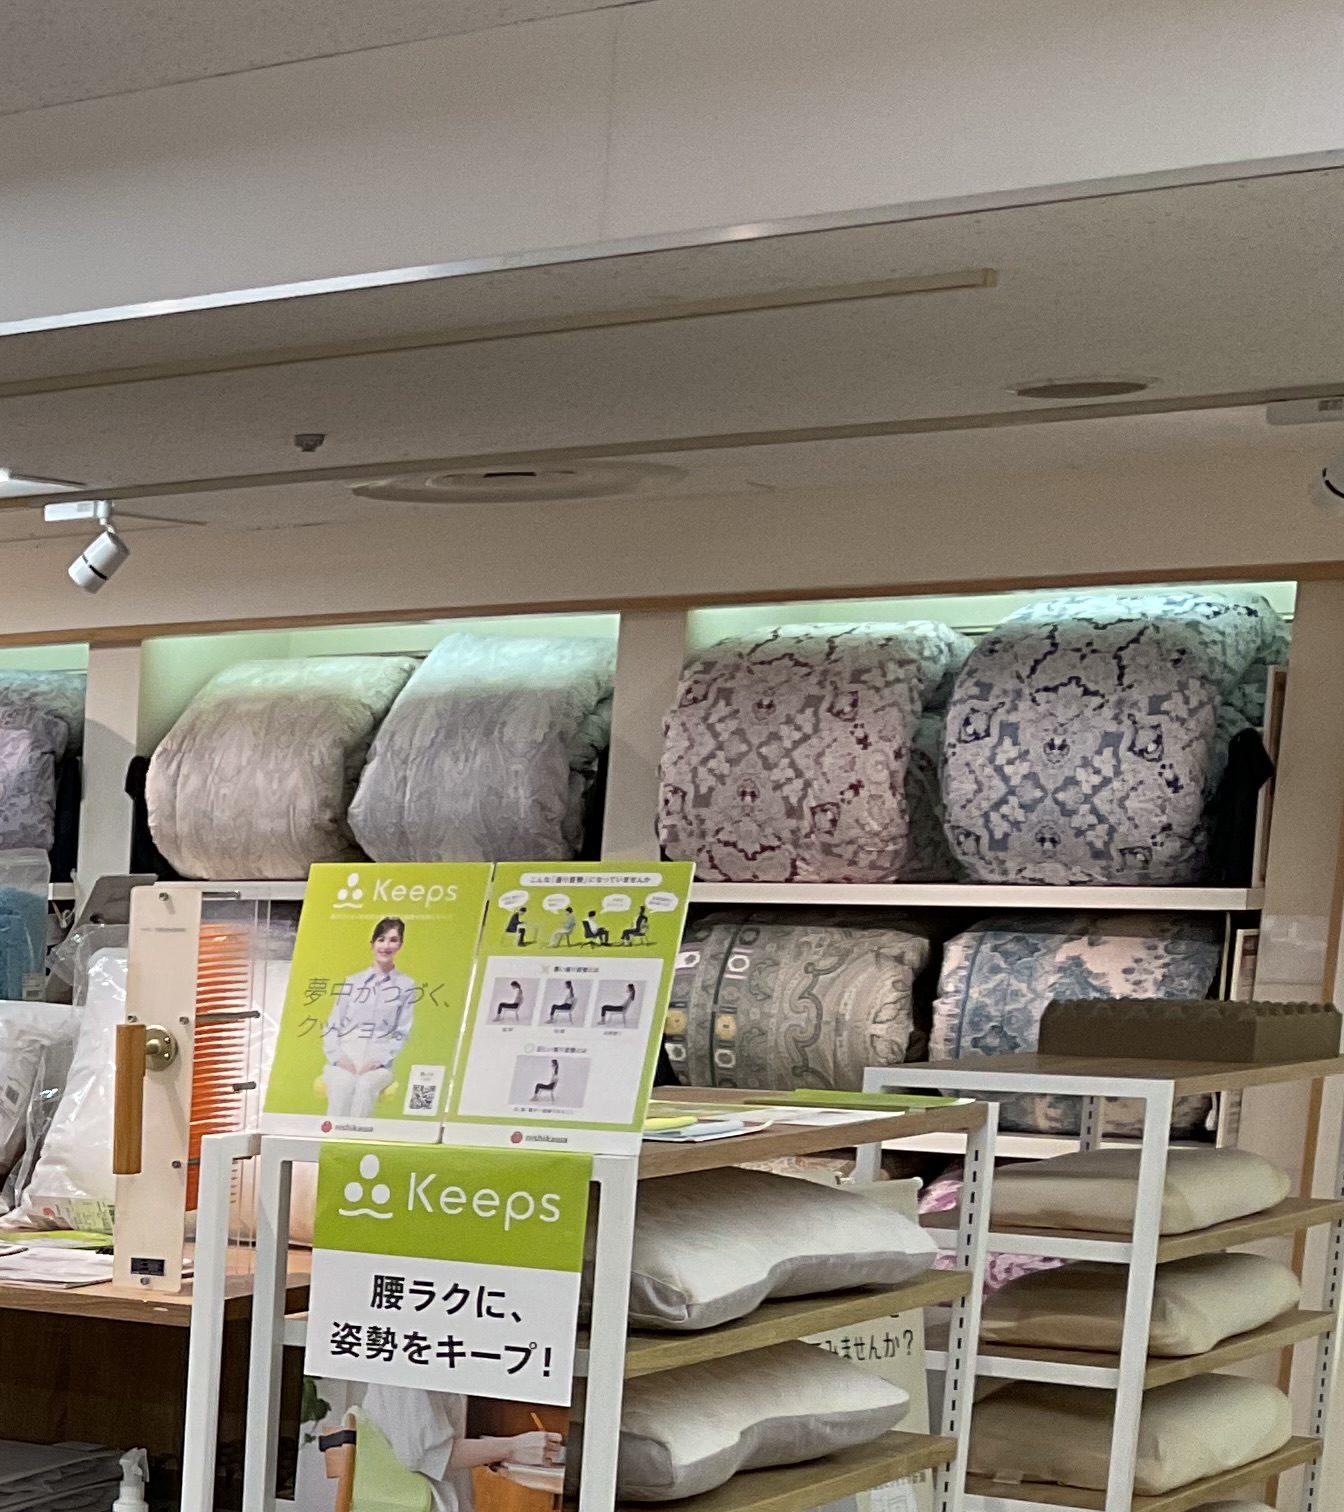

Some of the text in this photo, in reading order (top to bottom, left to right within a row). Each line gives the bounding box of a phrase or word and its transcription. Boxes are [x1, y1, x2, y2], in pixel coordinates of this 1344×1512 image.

[372, 879, 459, 908] Keeps
[303, 977, 450, 1007] 夢中がつづく、
[297, 1014, 408, 1041] クッション。
[407, 1172, 561, 1231] Keeps
[370, 1274, 522, 1323] 腰ラクに、
[330, 1321, 553, 1378] 姿勢をキープ!
